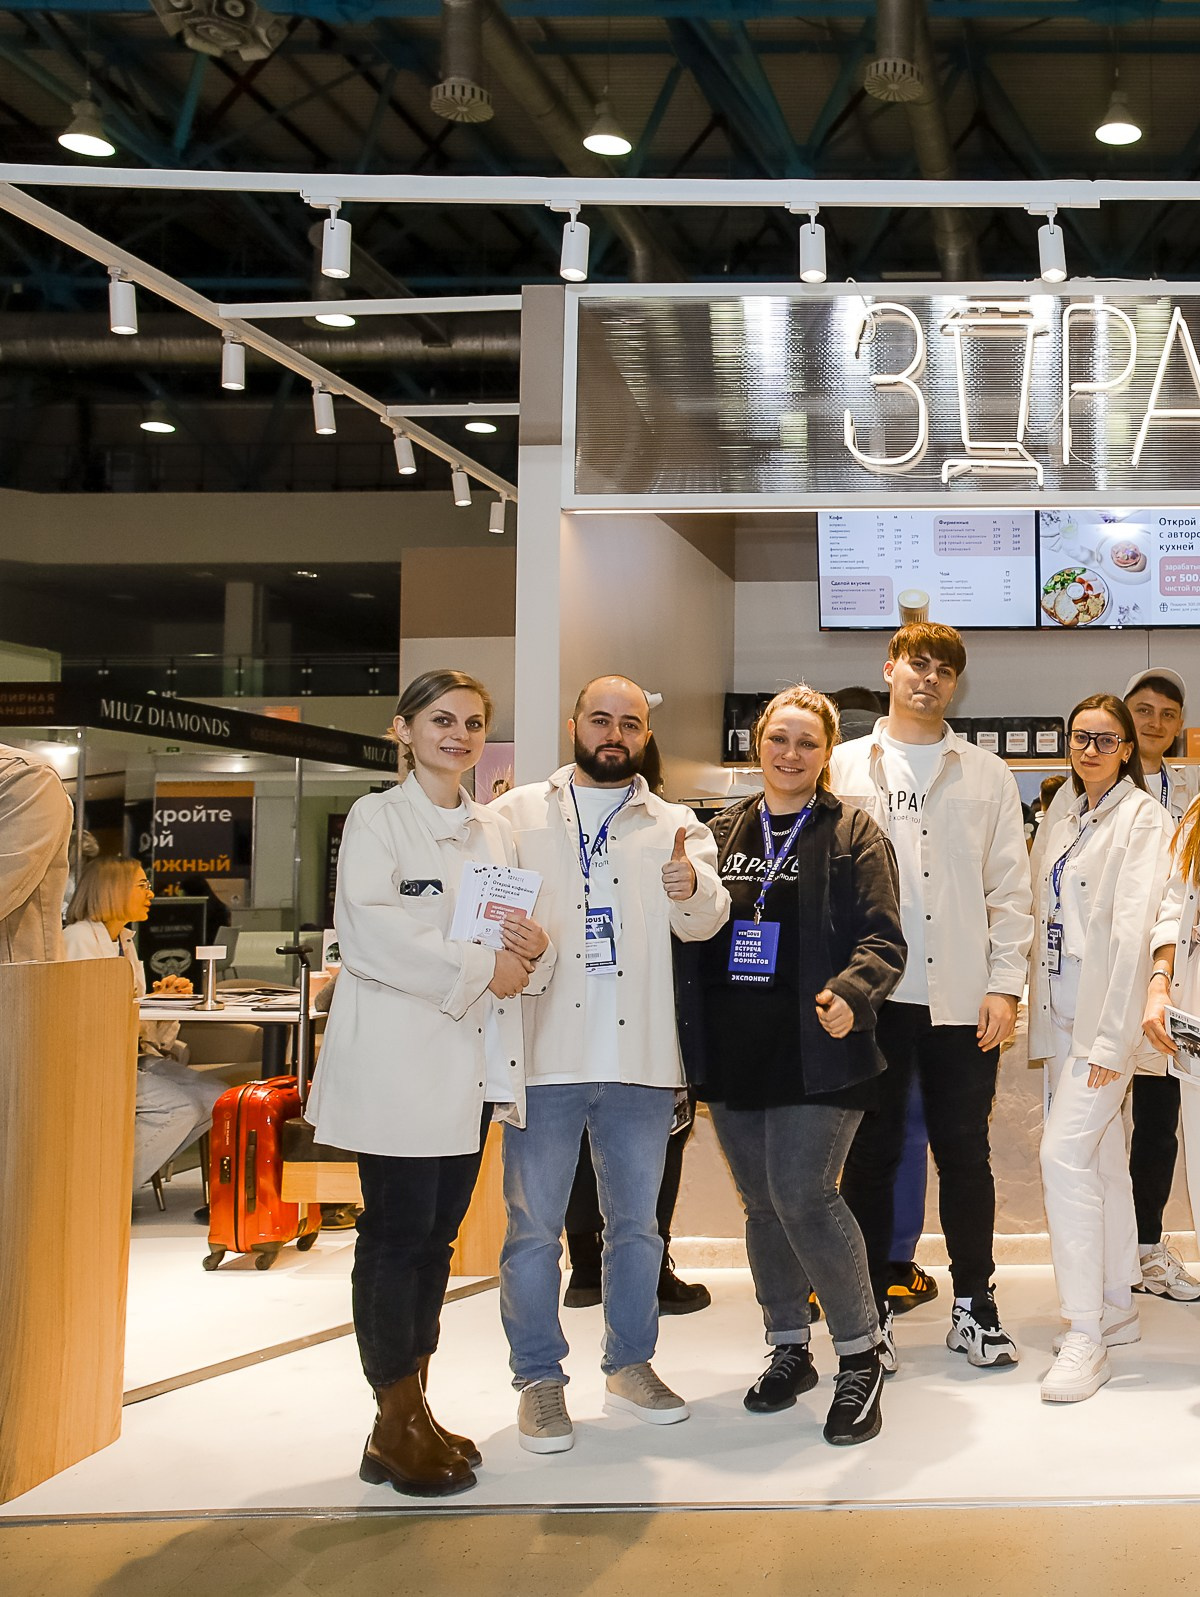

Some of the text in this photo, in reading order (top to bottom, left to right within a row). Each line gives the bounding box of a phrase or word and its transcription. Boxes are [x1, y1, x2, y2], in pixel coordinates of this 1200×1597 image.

[1159, 517, 1196, 528] Открой
[1160, 542, 1194, 552] кухней
[1165, 584, 1190, 592] чистой
[101, 699, 230, 738] MIUZ DIAMONDS
[363, 745, 386, 763] MIUZ
[493, 880, 511, 888] Открой
[731, 974, 770, 982] ЭКСПОНЕНТ
